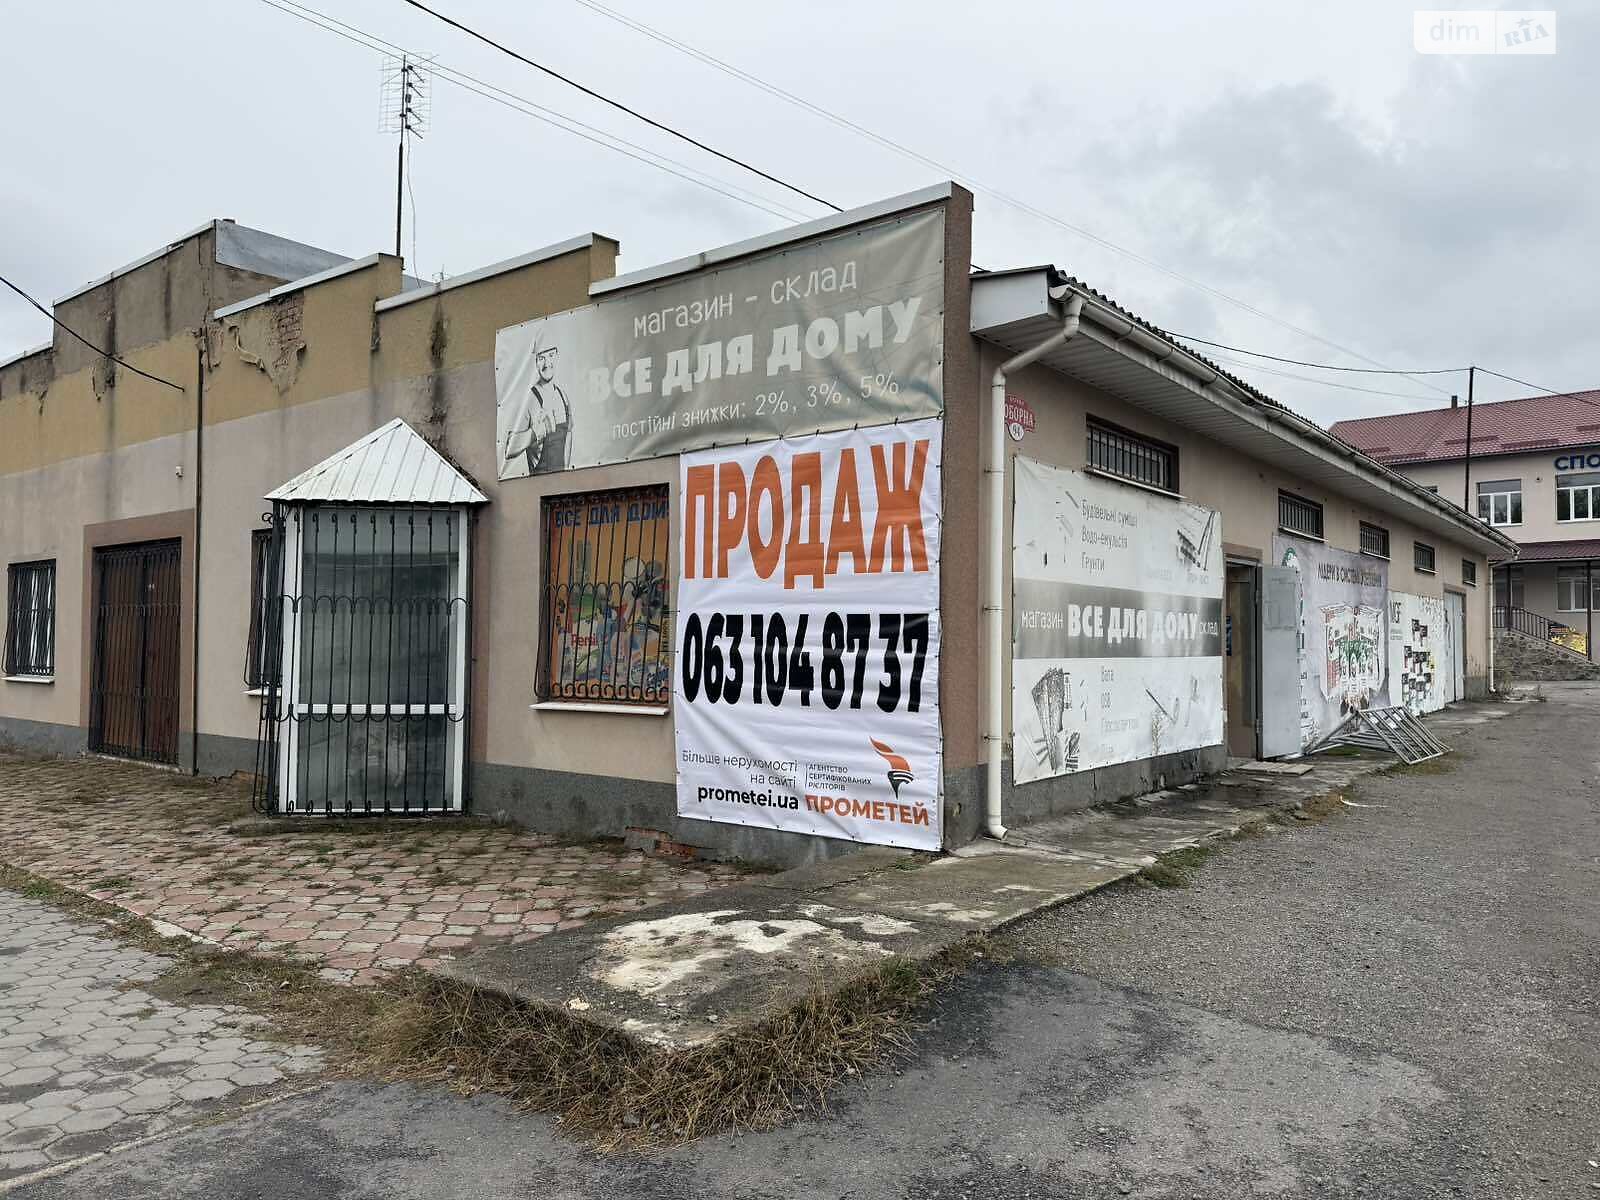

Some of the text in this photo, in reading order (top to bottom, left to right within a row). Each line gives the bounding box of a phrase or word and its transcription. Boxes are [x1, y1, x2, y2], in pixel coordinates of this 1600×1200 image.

[634, 293, 733, 339] магазин
[771, 261, 857, 304] склад
[585, 296, 923, 403] ВСЕ ДЛЯ ДОМУ
[612, 371, 899, 440] постійні знижки: 2%, 3%, 5%
[1004, 403, 1035, 427] ОБОРНА
[684, 439, 930, 589] ПРОДАЖ
[1021, 609, 1064, 629] магазин
[1067, 604, 1104, 637] ВСЕ
[1108, 607, 1147, 644] ДЛЯ
[1151, 610, 1198, 644] ДОМУ
[682, 750, 798, 773] Більше нерухомості
[698, 786, 799, 810] prometei.ua
[750, 774, 796, 788] на сайті
[804, 794, 929, 826] ПРОМЕТЕЙ
